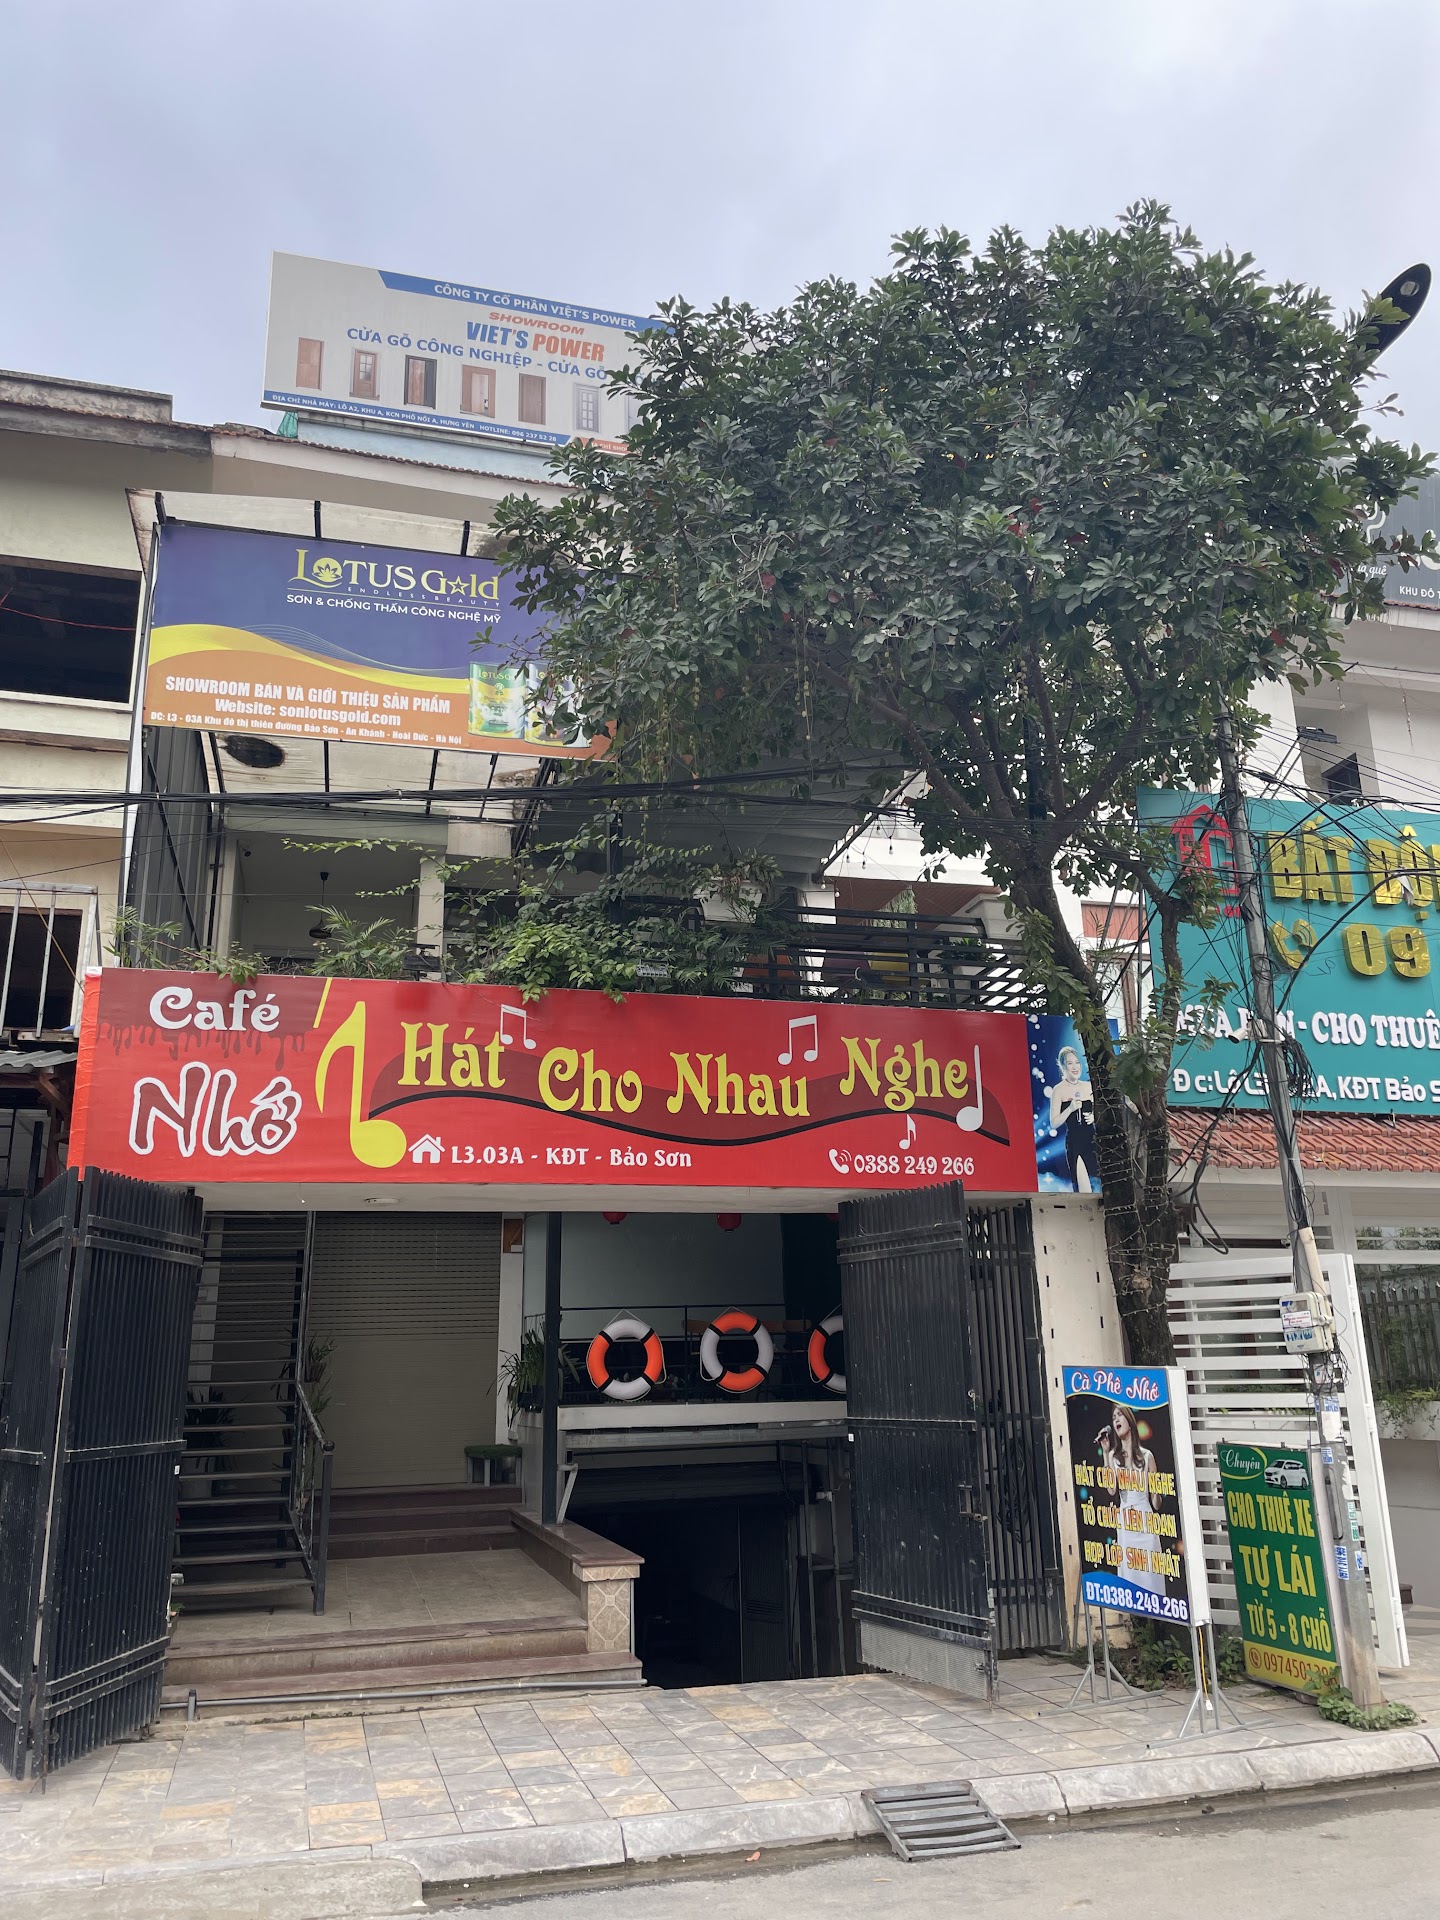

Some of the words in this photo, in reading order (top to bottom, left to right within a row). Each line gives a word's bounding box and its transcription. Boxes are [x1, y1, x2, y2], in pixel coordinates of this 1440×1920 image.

[435, 284, 470, 298] CÔNG
[474, 292, 490, 301] TY
[514, 298, 548, 312] PHẦN
[593, 313, 636, 328] POWER
[489, 312, 584, 335] SHOWROOM
[347, 326, 382, 344] CỬA
[388, 333, 412, 347] GỖ
[417, 338, 464, 356] CÔNG
[470, 348, 532, 368] NGHIỆP
[548, 360, 580, 376] CỬA
[585, 366, 607, 380] GỖ
[466, 322, 528, 348] VIET'S
[532, 334, 605, 362] POWER
[480, 425, 510, 435] HOTLINE:
[287, 594, 313, 605] SƠN
[315, 597, 324, 606] &
[326, 598, 371, 611] CHỐNG
[374, 602, 408, 614] THẤM
[411, 604, 445, 618] CÔNG
[448, 610, 481, 623] NGHỆ
[348, 587, 426, 600] ENDLESS
[1399, 586, 1418, 596] KHU
[166, 676, 250, 697] SHOWROOM
[254, 682, 282, 700] BÁN
[286, 684, 304, 701] VÀ
[308, 687, 337, 704] GIỚI
[340, 691, 379, 709] THIỆU
[382, 692, 409, 710] SẢN
[412, 694, 451, 714] PHẨM
[215, 699, 276, 716] Website:
[279, 706, 401, 726] sonlotusgold.com
[167, 713, 177, 722] L3
[185, 714, 202, 724] 03A
[205, 716, 221, 725] Khu
[346, 727, 357, 735] An
[359, 727, 385, 738] Khánh
[436, 734, 447, 743] Hà
[449, 735, 462, 744] Nội
[1263, 816, 1354, 906] BẤT
[1343, 923, 1431, 978] 09
[148, 986, 280, 1033] Café
[1312, 1012, 1367, 1046] CHO
[1371, 1009, 1440, 1050] THUÊ
[398, 1021, 506, 1088] Hát
[539, 1046, 643, 1114] Cho
[666, 1051, 811, 1117] Nhau
[840, 1036, 970, 1112] Nghe
[1385, 1076, 1426, 1102] Bảo
[451, 1146, 524, 1165] L3.03A
[546, 1147, 589, 1166] KĐT
[610, 1146, 648, 1167] Bảo
[654, 1150, 692, 1167] Sơn
[854, 1154, 900, 1174] 0388
[904, 1156, 938, 1175] 249
[942, 1157, 975, 1176] 266
[1071, 1371, 1092, 1393] Cà
[1094, 1370, 1122, 1395] Phê
[1126, 1377, 1160, 1402] Nhớ
[1074, 1460, 1094, 1487] HÁT
[1096, 1466, 1116, 1489] CHO
[1117, 1468, 1146, 1492] NHAU
[1220, 1449, 1261, 1474] Chuyên
[1081, 1496, 1096, 1526] TỔ
[1097, 1502, 1122, 1529] CHỨC
[1123, 1505, 1144, 1533] LIÊN
[1146, 1511, 1177, 1538] HOAN
[1227, 1490, 1256, 1530] CHO
[1256, 1490, 1294, 1534] THUÊ
[1294, 1498, 1315, 1537] XE
[1105, 1540, 1123, 1567] LỚP
[1126, 1547, 1149, 1572] SINH
[1151, 1548, 1181, 1582] NHẬT
[1238, 1545, 1270, 1597] TỰ
[1274, 1544, 1317, 1597] LÁI
[1086, 1582, 1188, 1620] ĐT:0388.249.266
[1247, 1598, 1265, 1638] TỪ
[1266, 1608, 1277, 1640] 5
[1288, 1612, 1299, 1646] 8
[1301, 1607, 1332, 1654] CHỖ
